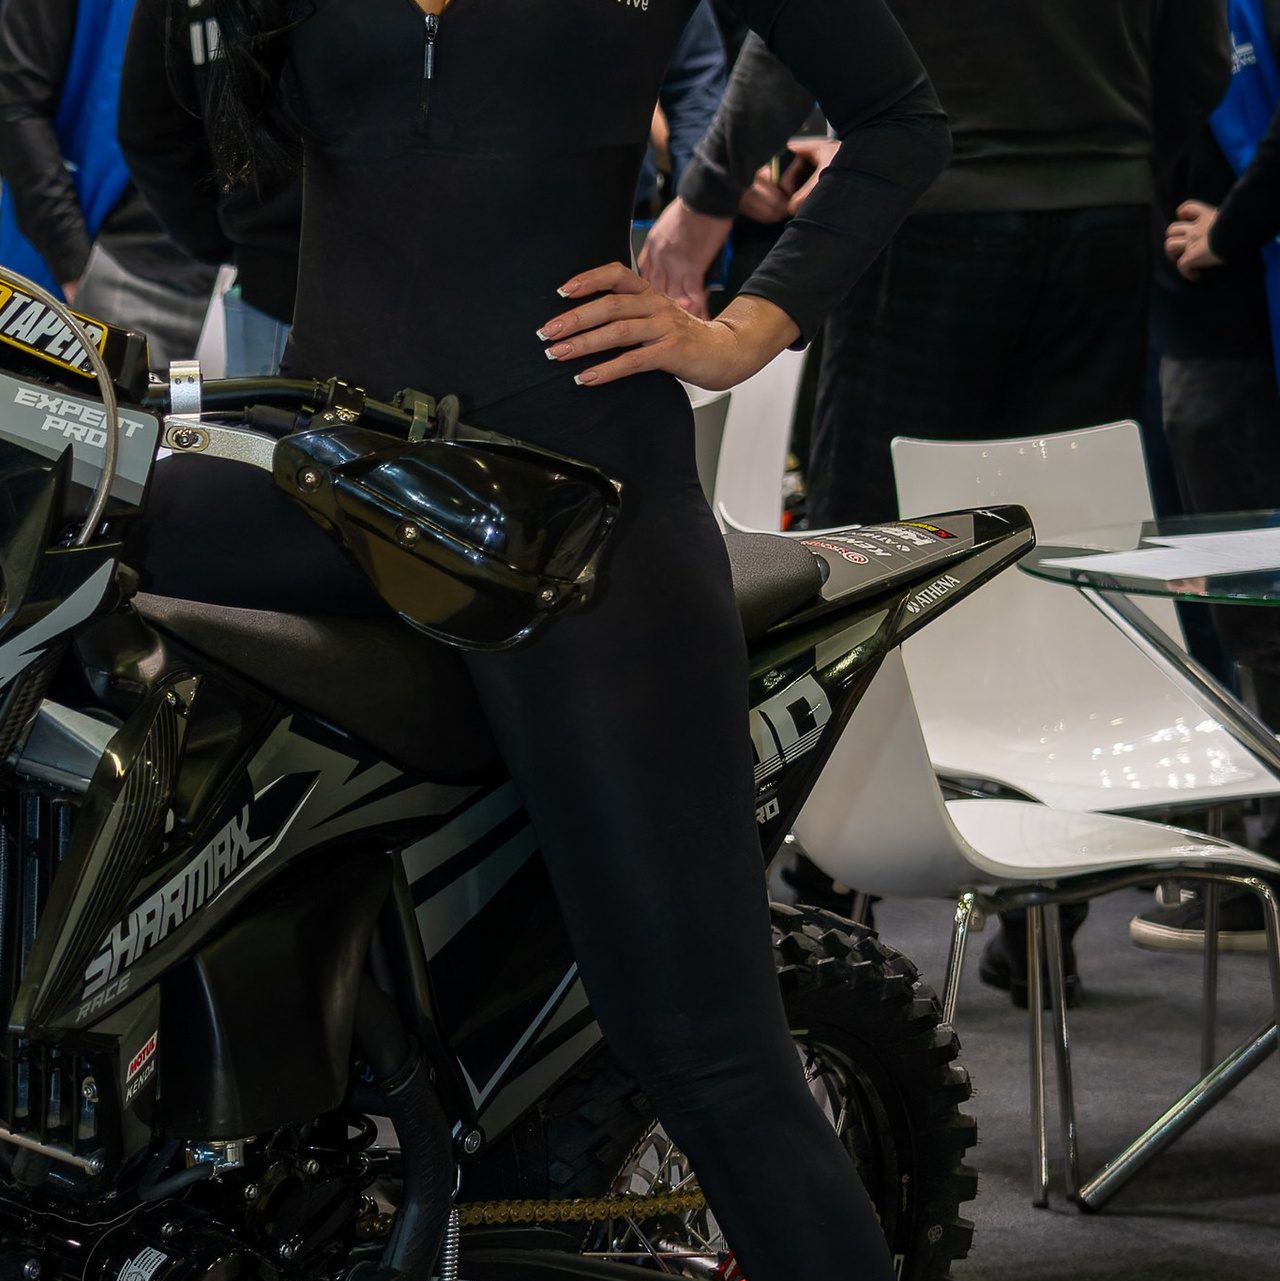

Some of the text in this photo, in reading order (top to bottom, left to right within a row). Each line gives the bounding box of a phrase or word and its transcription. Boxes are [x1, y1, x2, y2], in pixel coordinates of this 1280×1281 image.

[41, 414, 107, 449] PRO
[917, 574, 961, 608] ATHENA
[82, 804, 272, 1001] SHARMAX
[76, 972, 132, 1023] RACE
